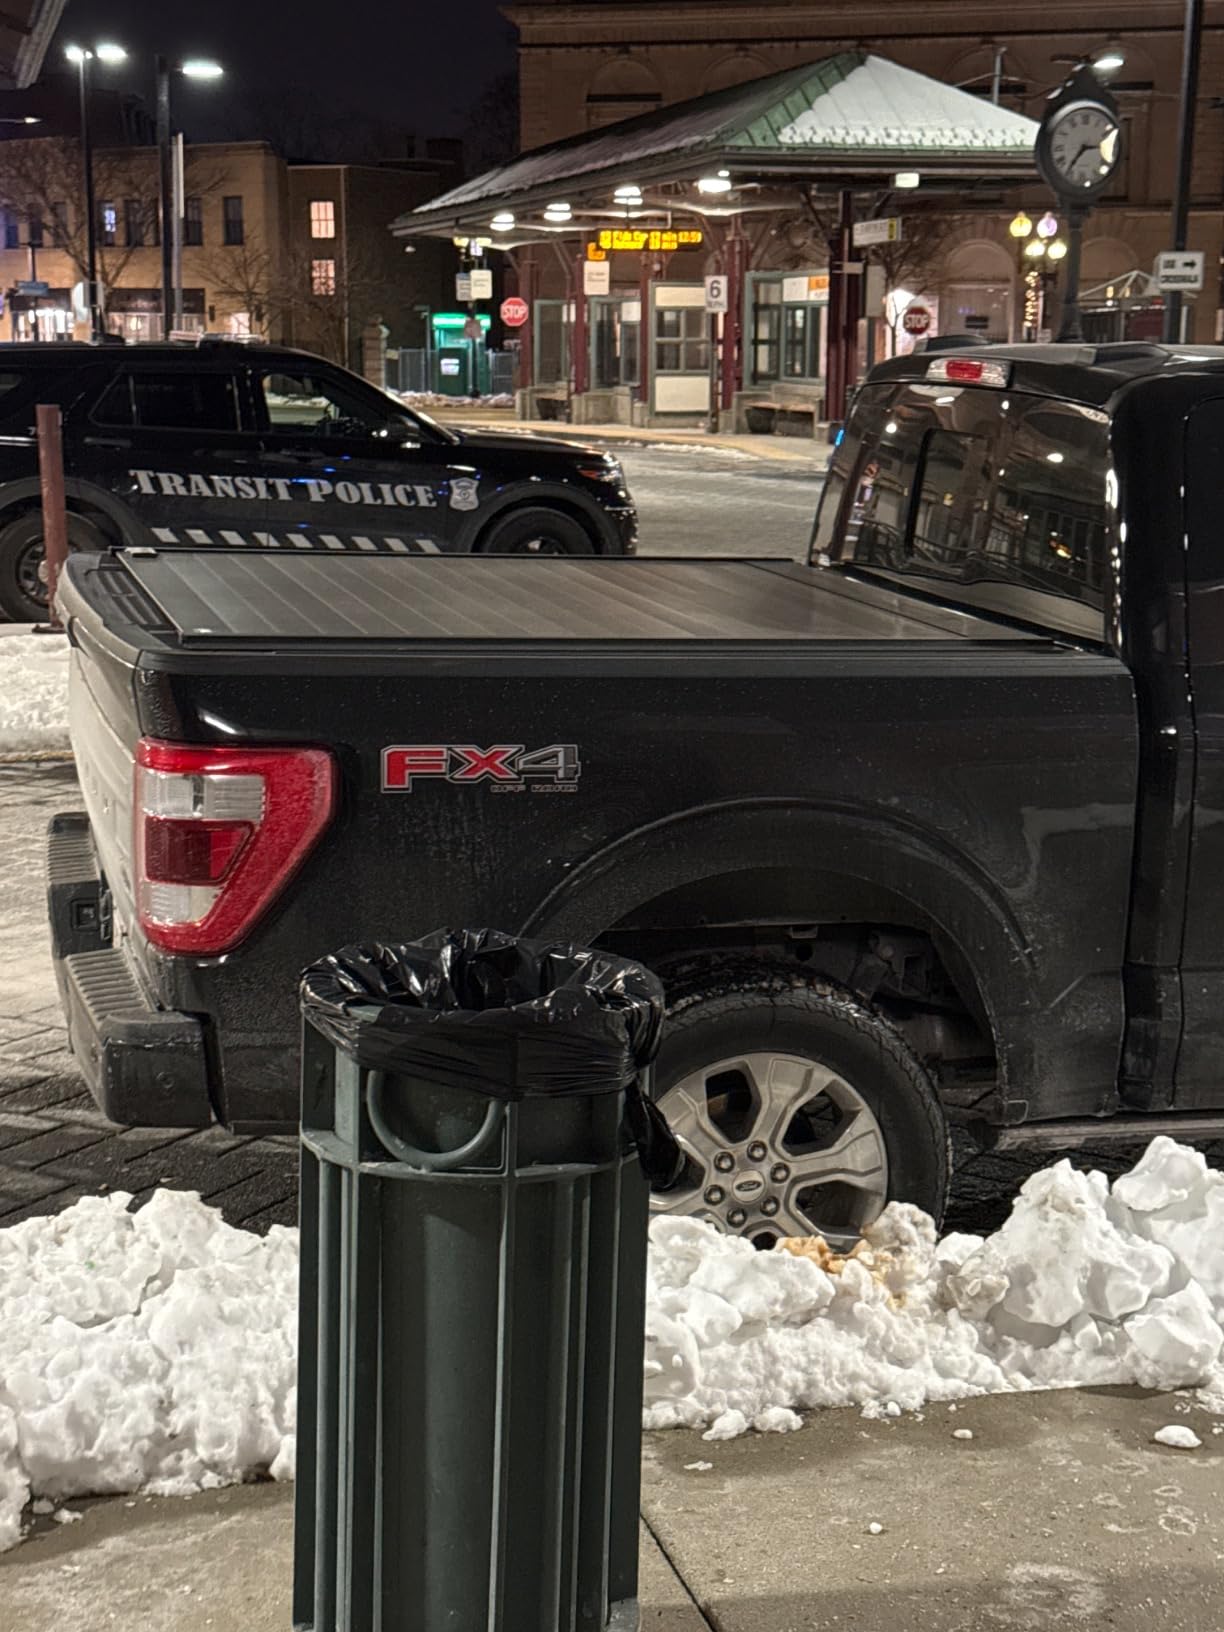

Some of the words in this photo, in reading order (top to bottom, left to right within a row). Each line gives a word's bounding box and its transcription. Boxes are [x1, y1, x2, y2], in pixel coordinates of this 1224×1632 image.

[710, 280, 721, 299] 6
[503, 305, 526, 319] STOP
[905, 314, 929, 328] STOP
[129, 469, 293, 502] TRANSIT
[306, 479, 438, 508] POLICE
[380, 744, 581, 793] FX4
